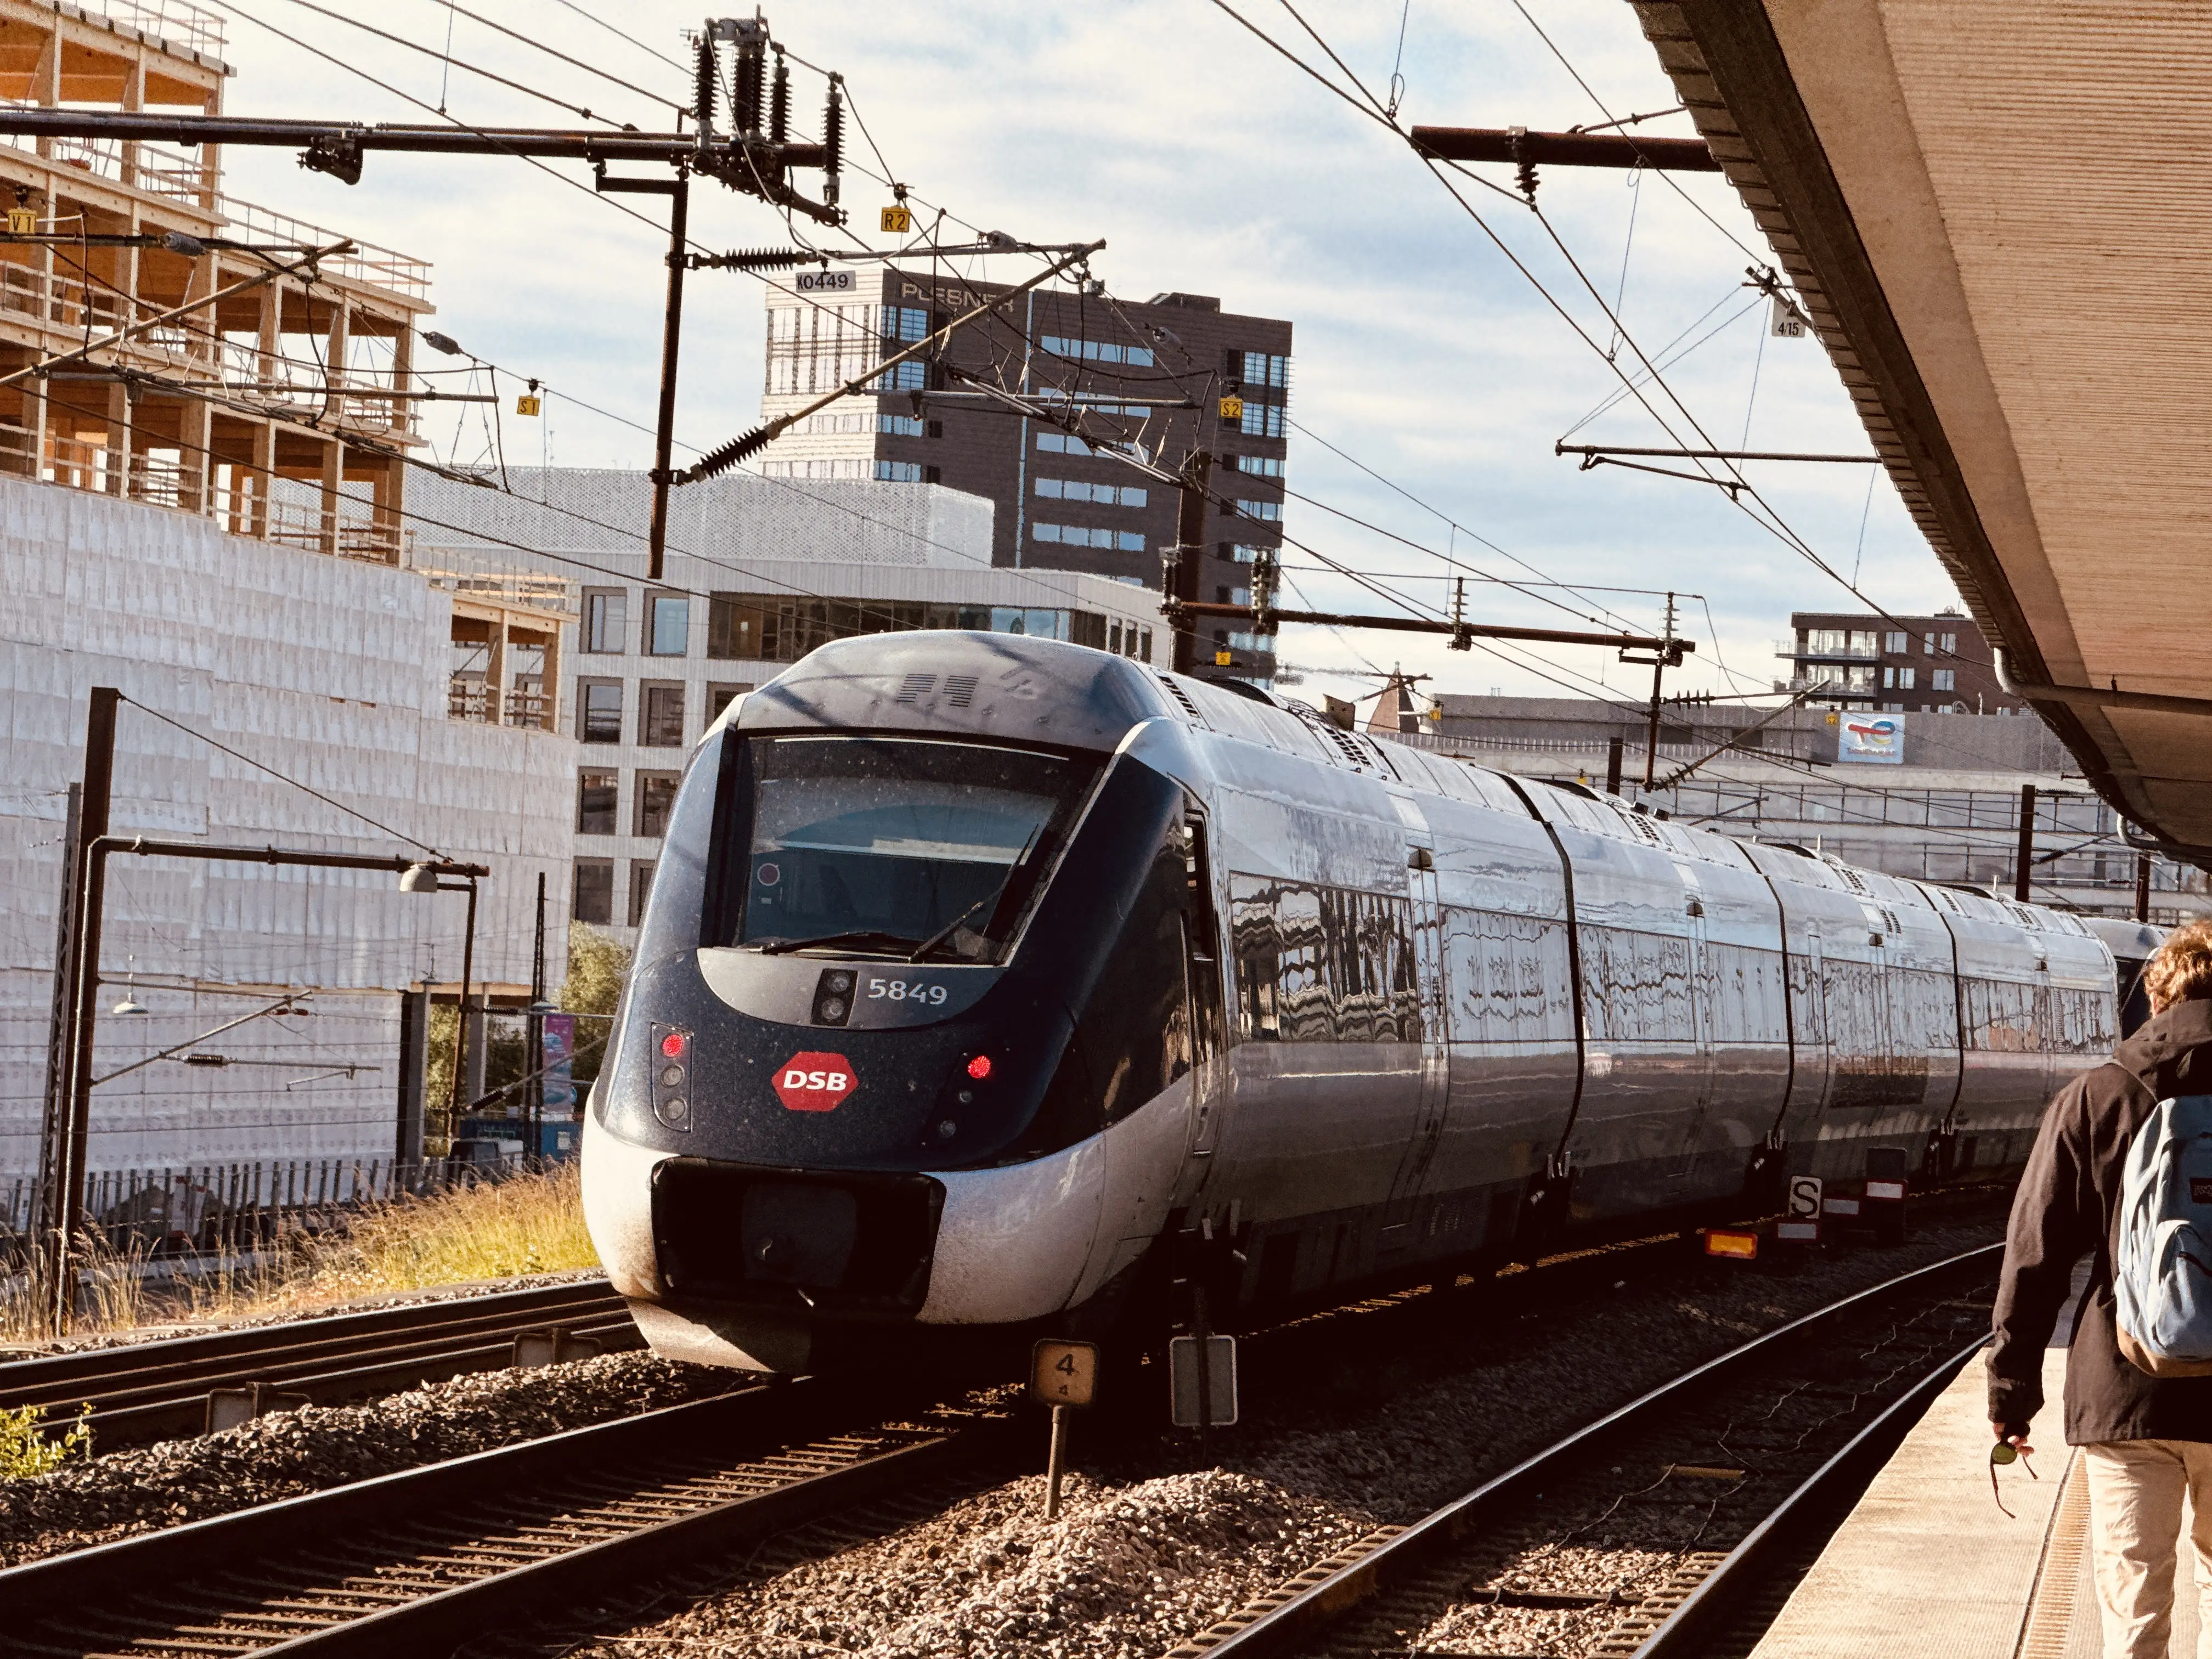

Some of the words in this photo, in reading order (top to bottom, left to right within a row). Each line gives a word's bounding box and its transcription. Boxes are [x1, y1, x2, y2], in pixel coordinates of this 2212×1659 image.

[885, 213, 905, 230] R2
[1778, 321, 1799, 336] 4/15
[1223, 403, 1239, 416] S2
[868, 978, 947, 1005] 5849
[783, 1070, 848, 1091] DSB
[1791, 1181, 1819, 1216] S
[1056, 1353, 1076, 1375] 4
